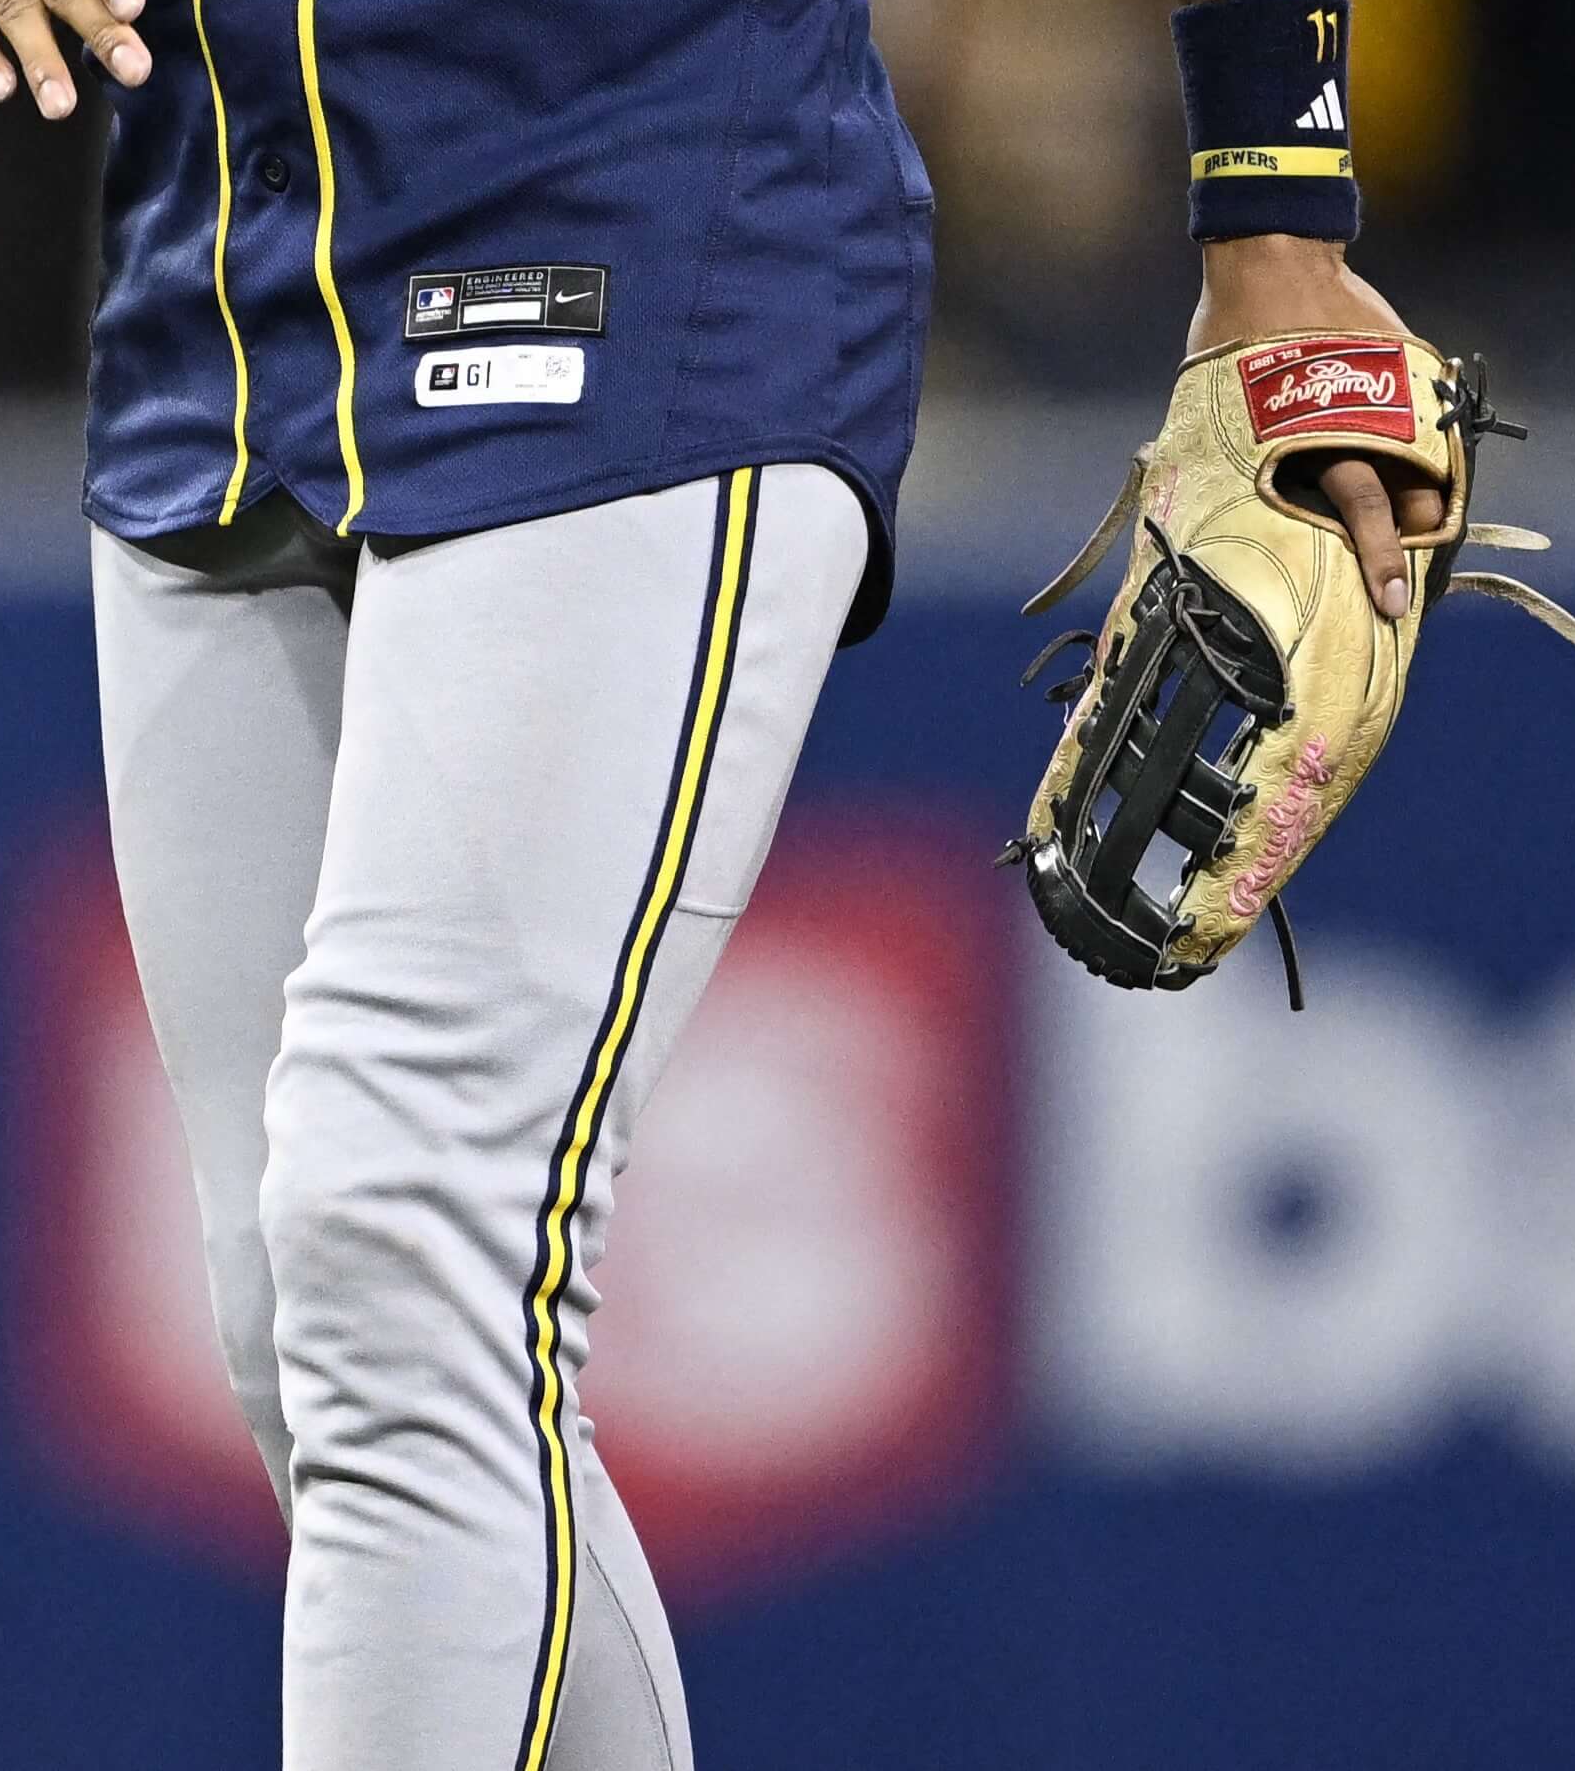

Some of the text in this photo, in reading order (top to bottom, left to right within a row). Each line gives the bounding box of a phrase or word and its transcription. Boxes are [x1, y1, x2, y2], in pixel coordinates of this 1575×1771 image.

[1307, 8, 1338, 64] 11
[1204, 150, 1279, 175] BREWERS
[466, 271, 544, 286] ENGINEERED
[1262, 370, 1397, 412] Rawlings
[1228, 732, 1332, 917] Rawlings
